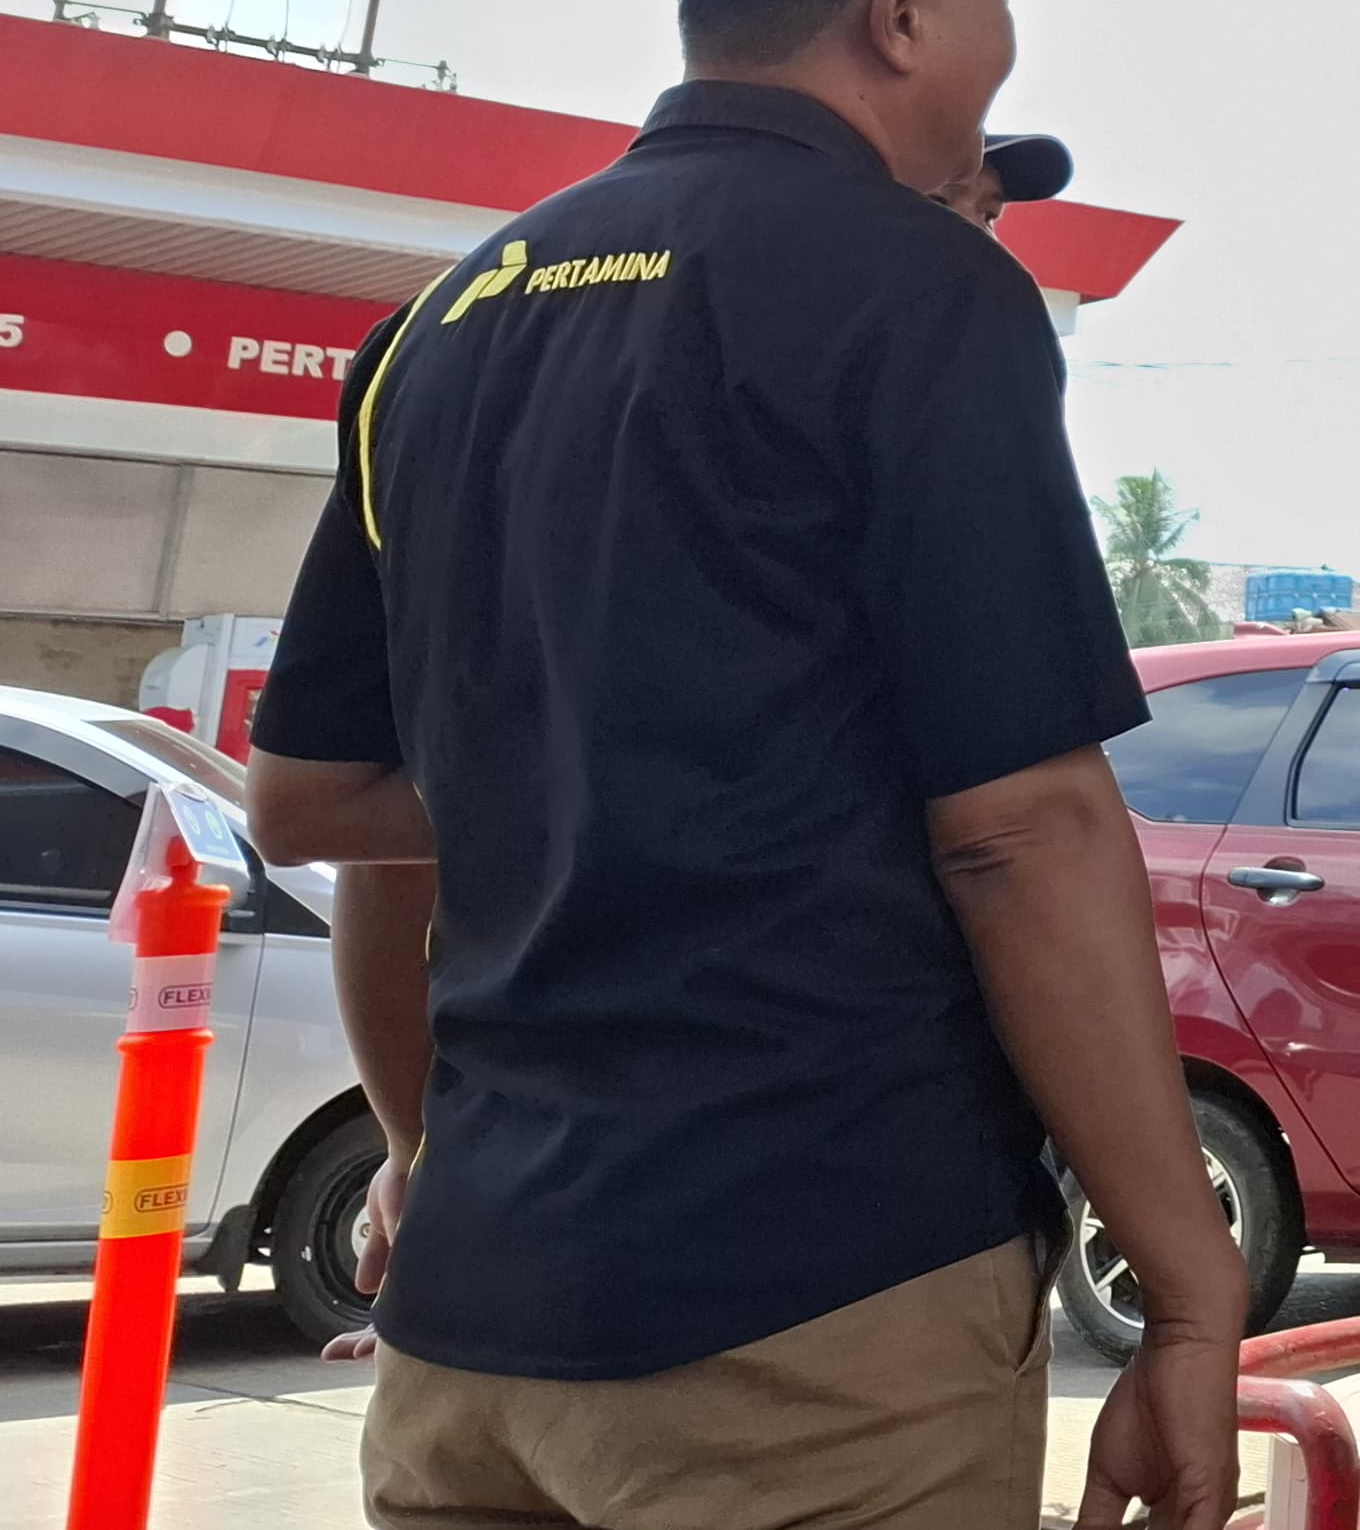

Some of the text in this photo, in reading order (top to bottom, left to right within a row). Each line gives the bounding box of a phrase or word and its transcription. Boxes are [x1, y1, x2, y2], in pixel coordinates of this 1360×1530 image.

[525, 250, 671, 295] PERTAMINA
[0, 313, 25, 348] 5
[227, 336, 357, 381] PERT
